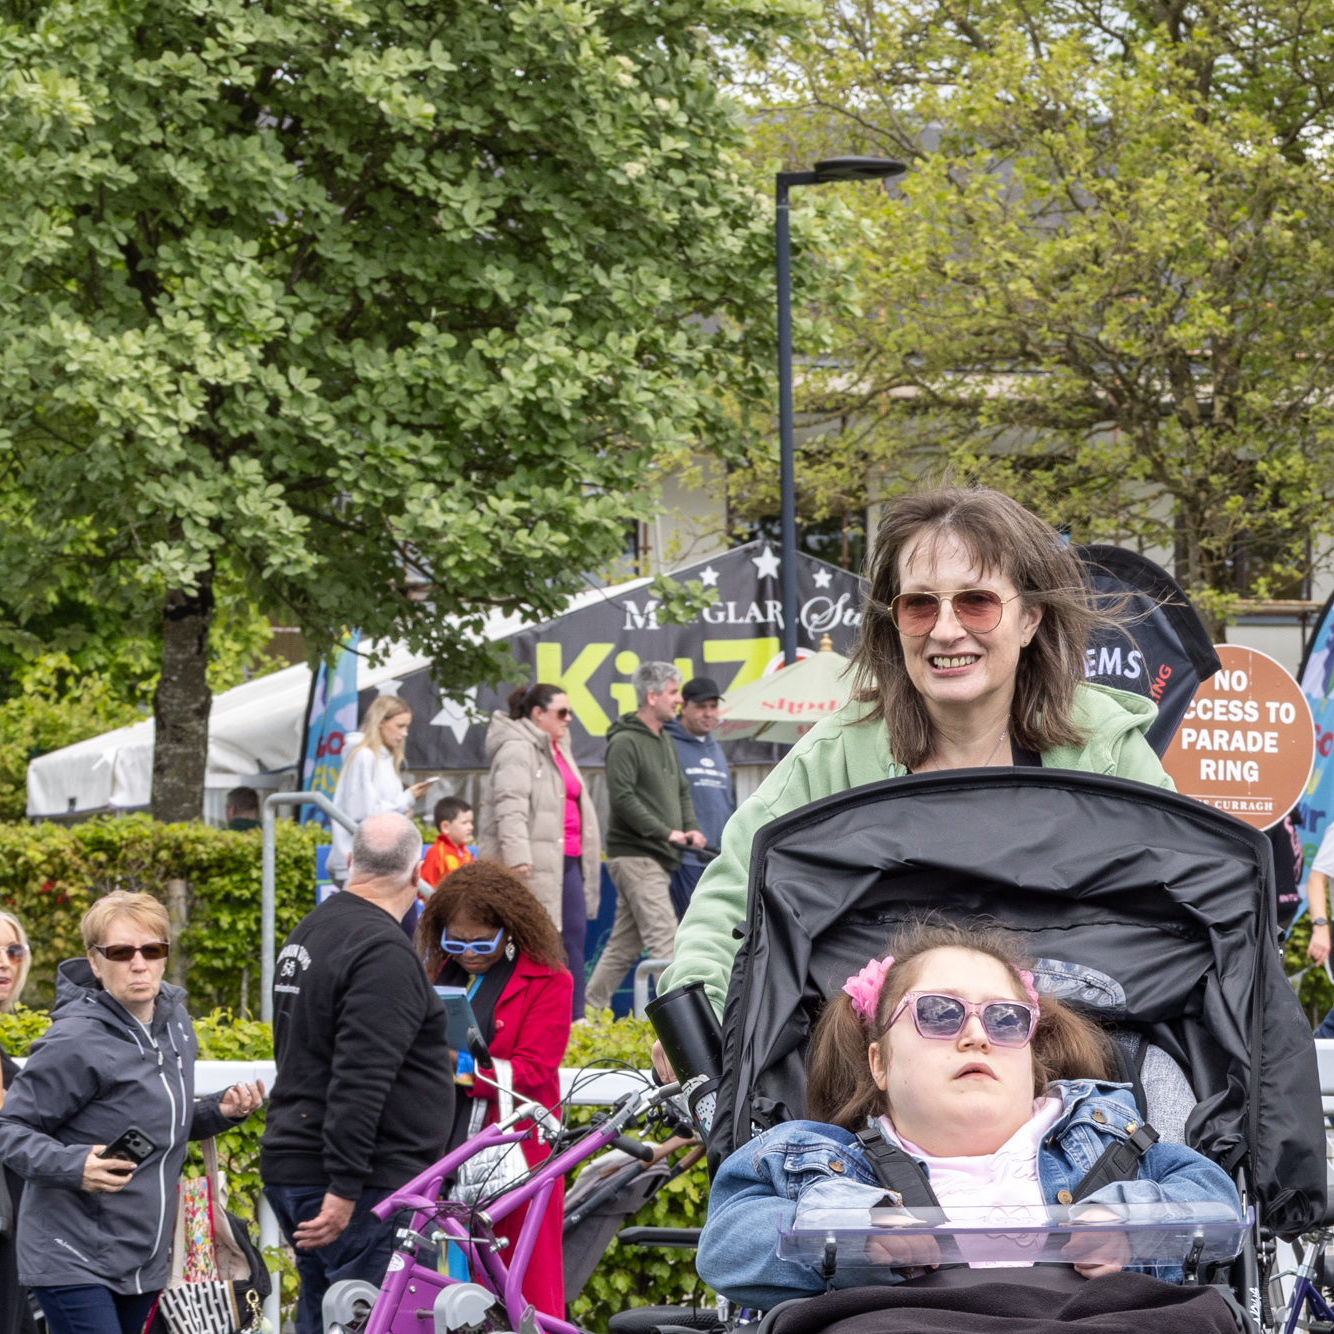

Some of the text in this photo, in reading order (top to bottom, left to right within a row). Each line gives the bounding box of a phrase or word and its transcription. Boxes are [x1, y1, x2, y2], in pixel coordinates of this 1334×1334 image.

[1214, 670, 1248, 692] NO
[1183, 699, 1296, 724] CCESS TO
[1181, 728, 1279, 753] PARADE
[1200, 759, 1259, 782] RING
[1214, 801, 1273, 810] CURRAGH
